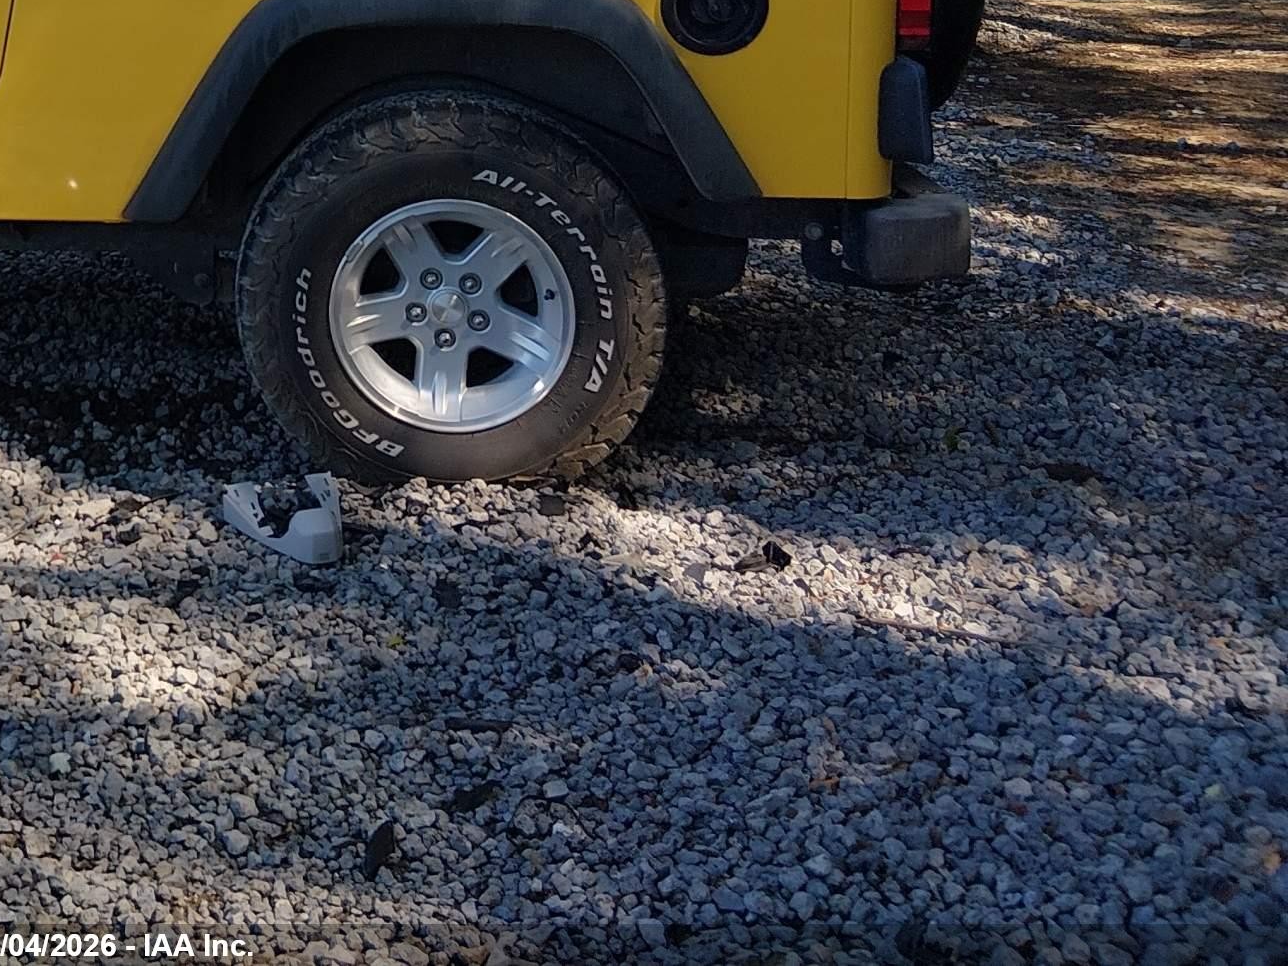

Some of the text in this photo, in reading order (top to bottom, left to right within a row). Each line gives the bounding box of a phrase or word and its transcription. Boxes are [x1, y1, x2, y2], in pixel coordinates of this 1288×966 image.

[292, 267, 406, 459] BFGoodrich
[472, 168, 616, 394] All-Terrain T/A
